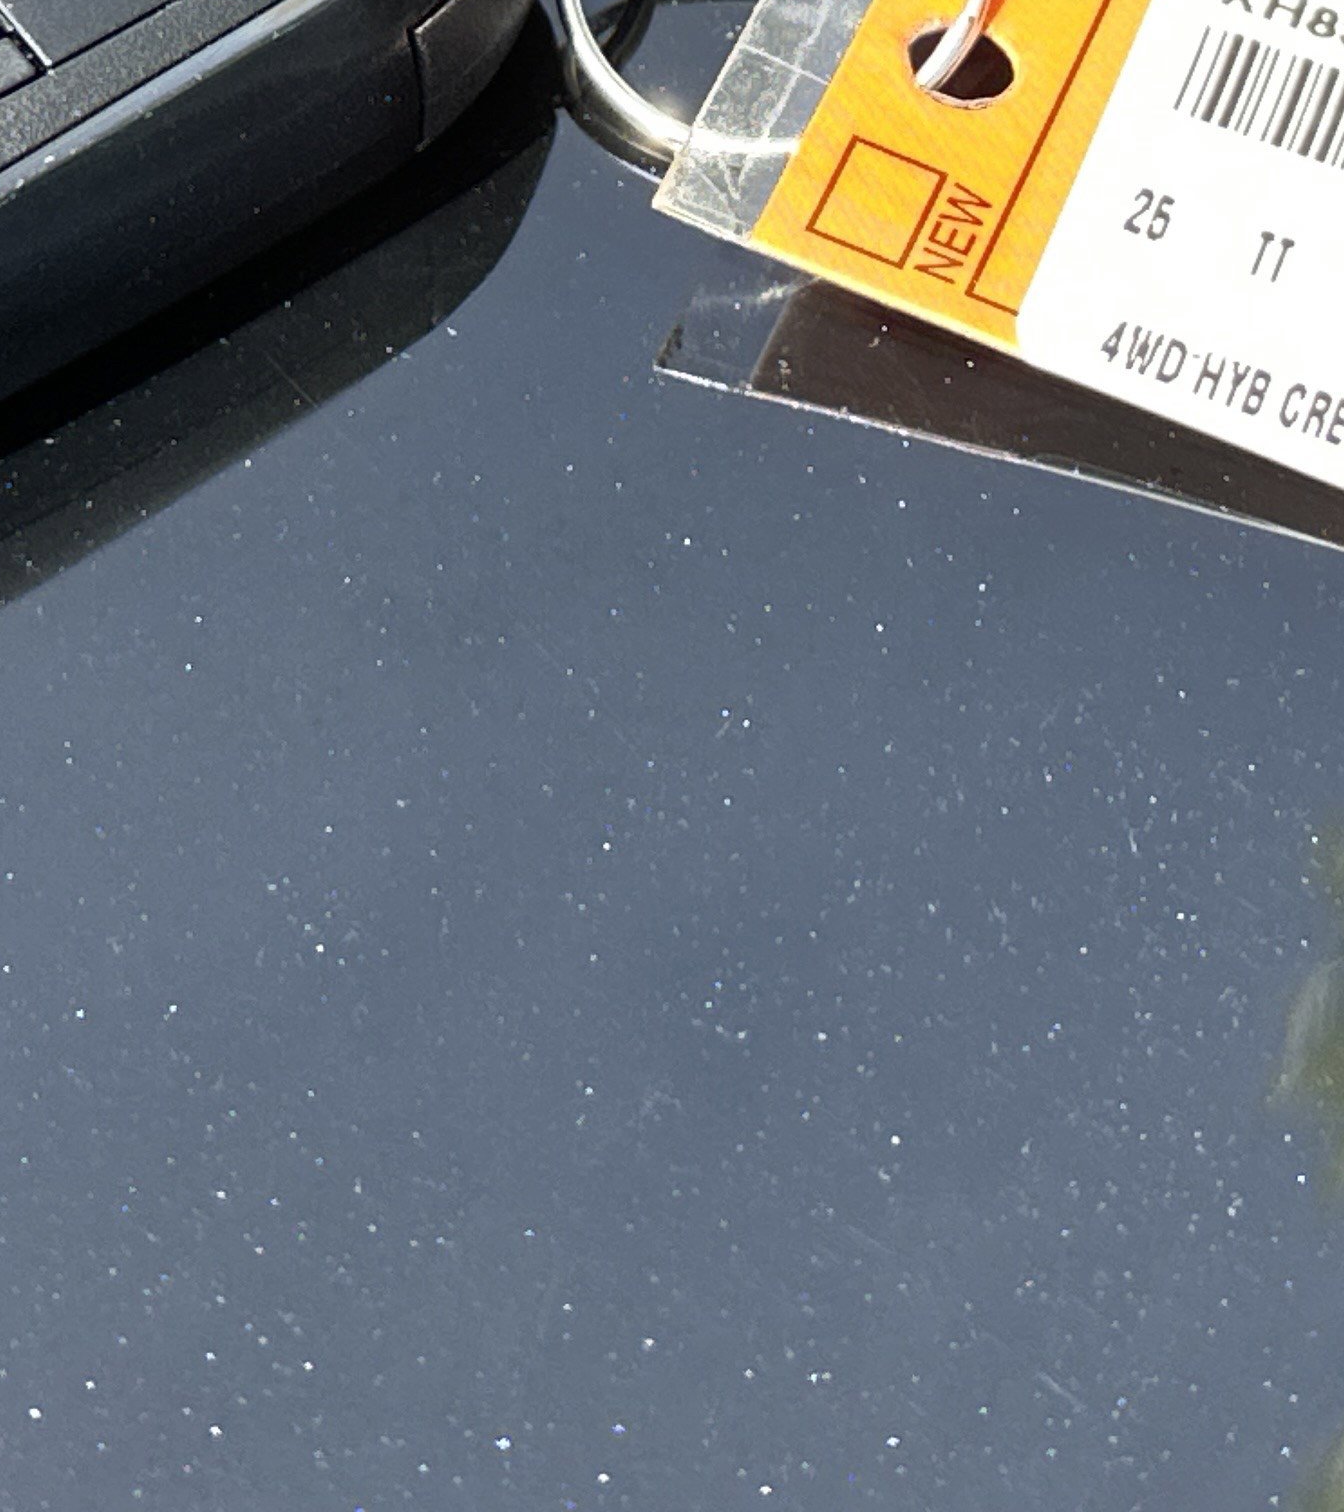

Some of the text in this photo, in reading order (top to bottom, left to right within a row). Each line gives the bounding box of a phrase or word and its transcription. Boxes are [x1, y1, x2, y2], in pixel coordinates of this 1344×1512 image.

[915, 183, 993, 284] NEW
[1123, 189, 1294, 282] 25 TT
[1101, 322, 1187, 383] 4WD
[1194, 352, 1271, 415] HYB
